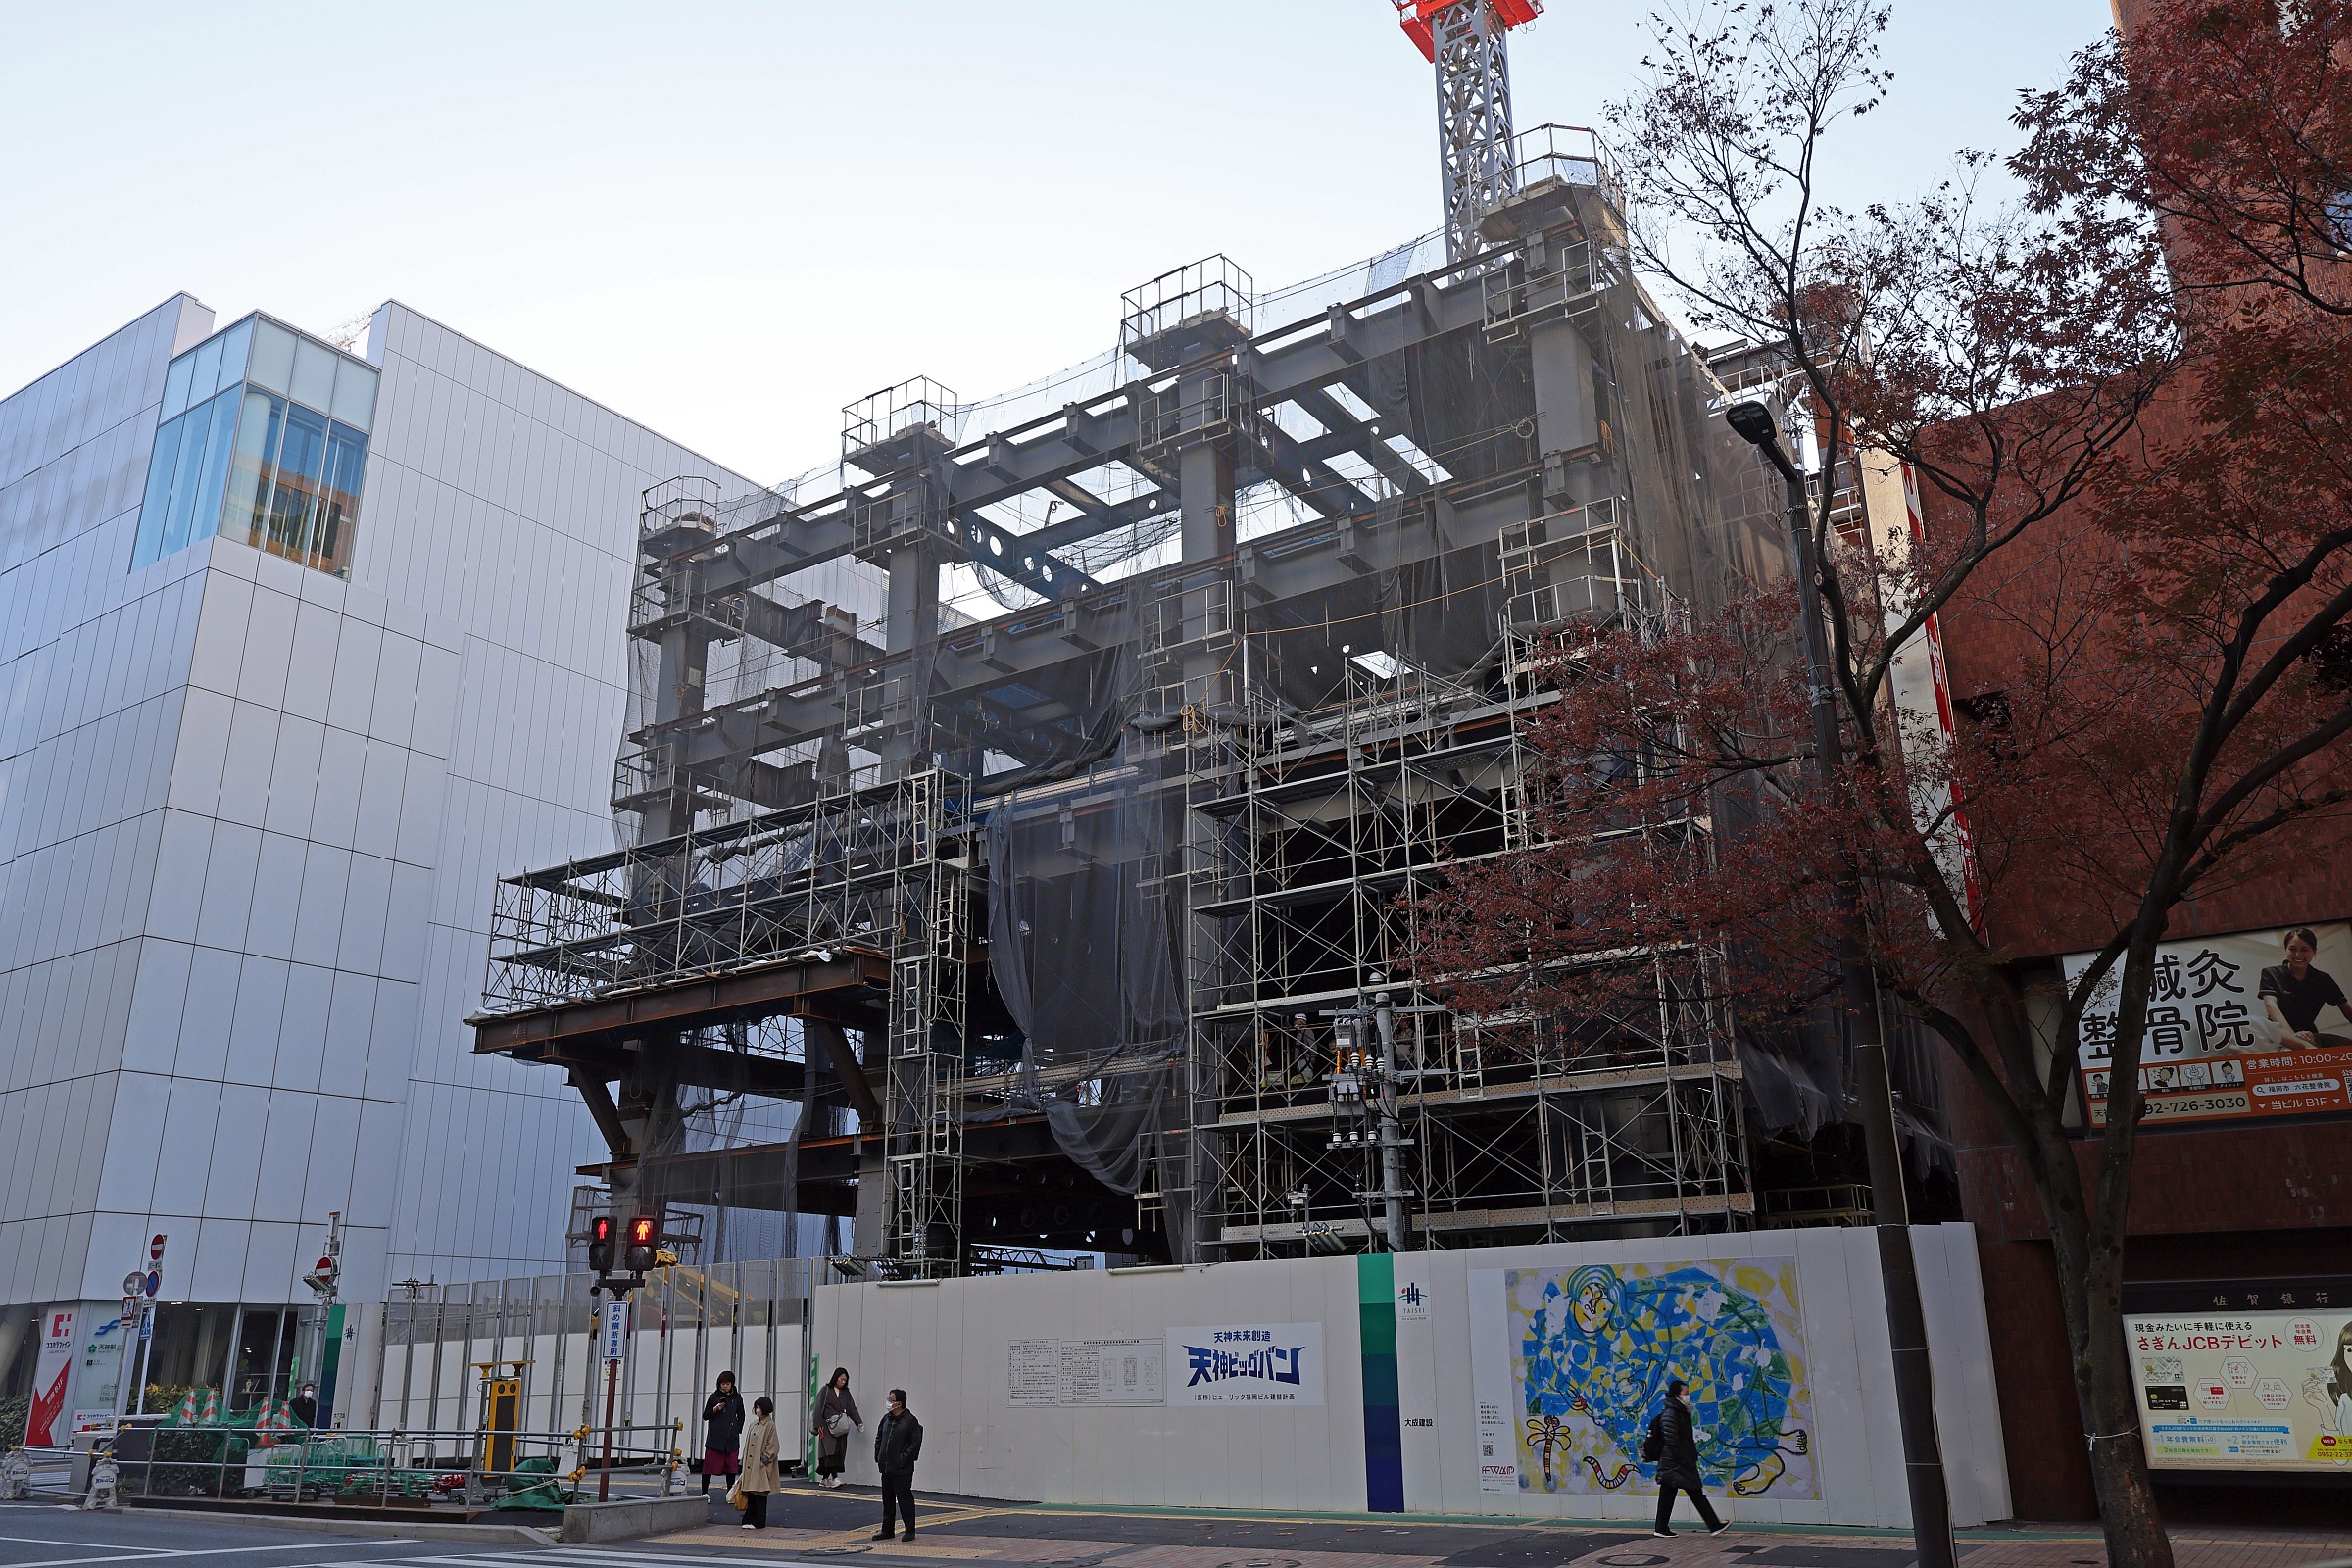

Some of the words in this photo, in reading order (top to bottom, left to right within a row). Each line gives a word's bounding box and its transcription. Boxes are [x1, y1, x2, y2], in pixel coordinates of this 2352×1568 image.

[2080, 999, 2255, 1062] 整骨院
[2294, 1081, 2331, 1091] 六花整骨院
[2145, 1096, 2246, 1115] 92-726-3030
[2271, 1099, 2303, 1110] 当ビル
[2305, 1097, 2327, 1107] B1F
[2213, 1292, 2328, 1307] 佐賀銀行
[609, 1304, 621, 1356] 斜め横断専用
[2134, 1321, 2252, 1333] 現金みたいに手軽に使える
[1213, 1329, 1271, 1344] 天神未来創造
[2136, 1333, 2283, 1351] さぎんJCBデビット
[2293, 1334, 2317, 1345] 無料
[1181, 1344, 1306, 1388] 天神ビッグバン
[1194, 1393, 1295, 1401] (仮称)ヒューリック福岡ビル建替計画
[1404, 1418, 1434, 1427] 大成建設
